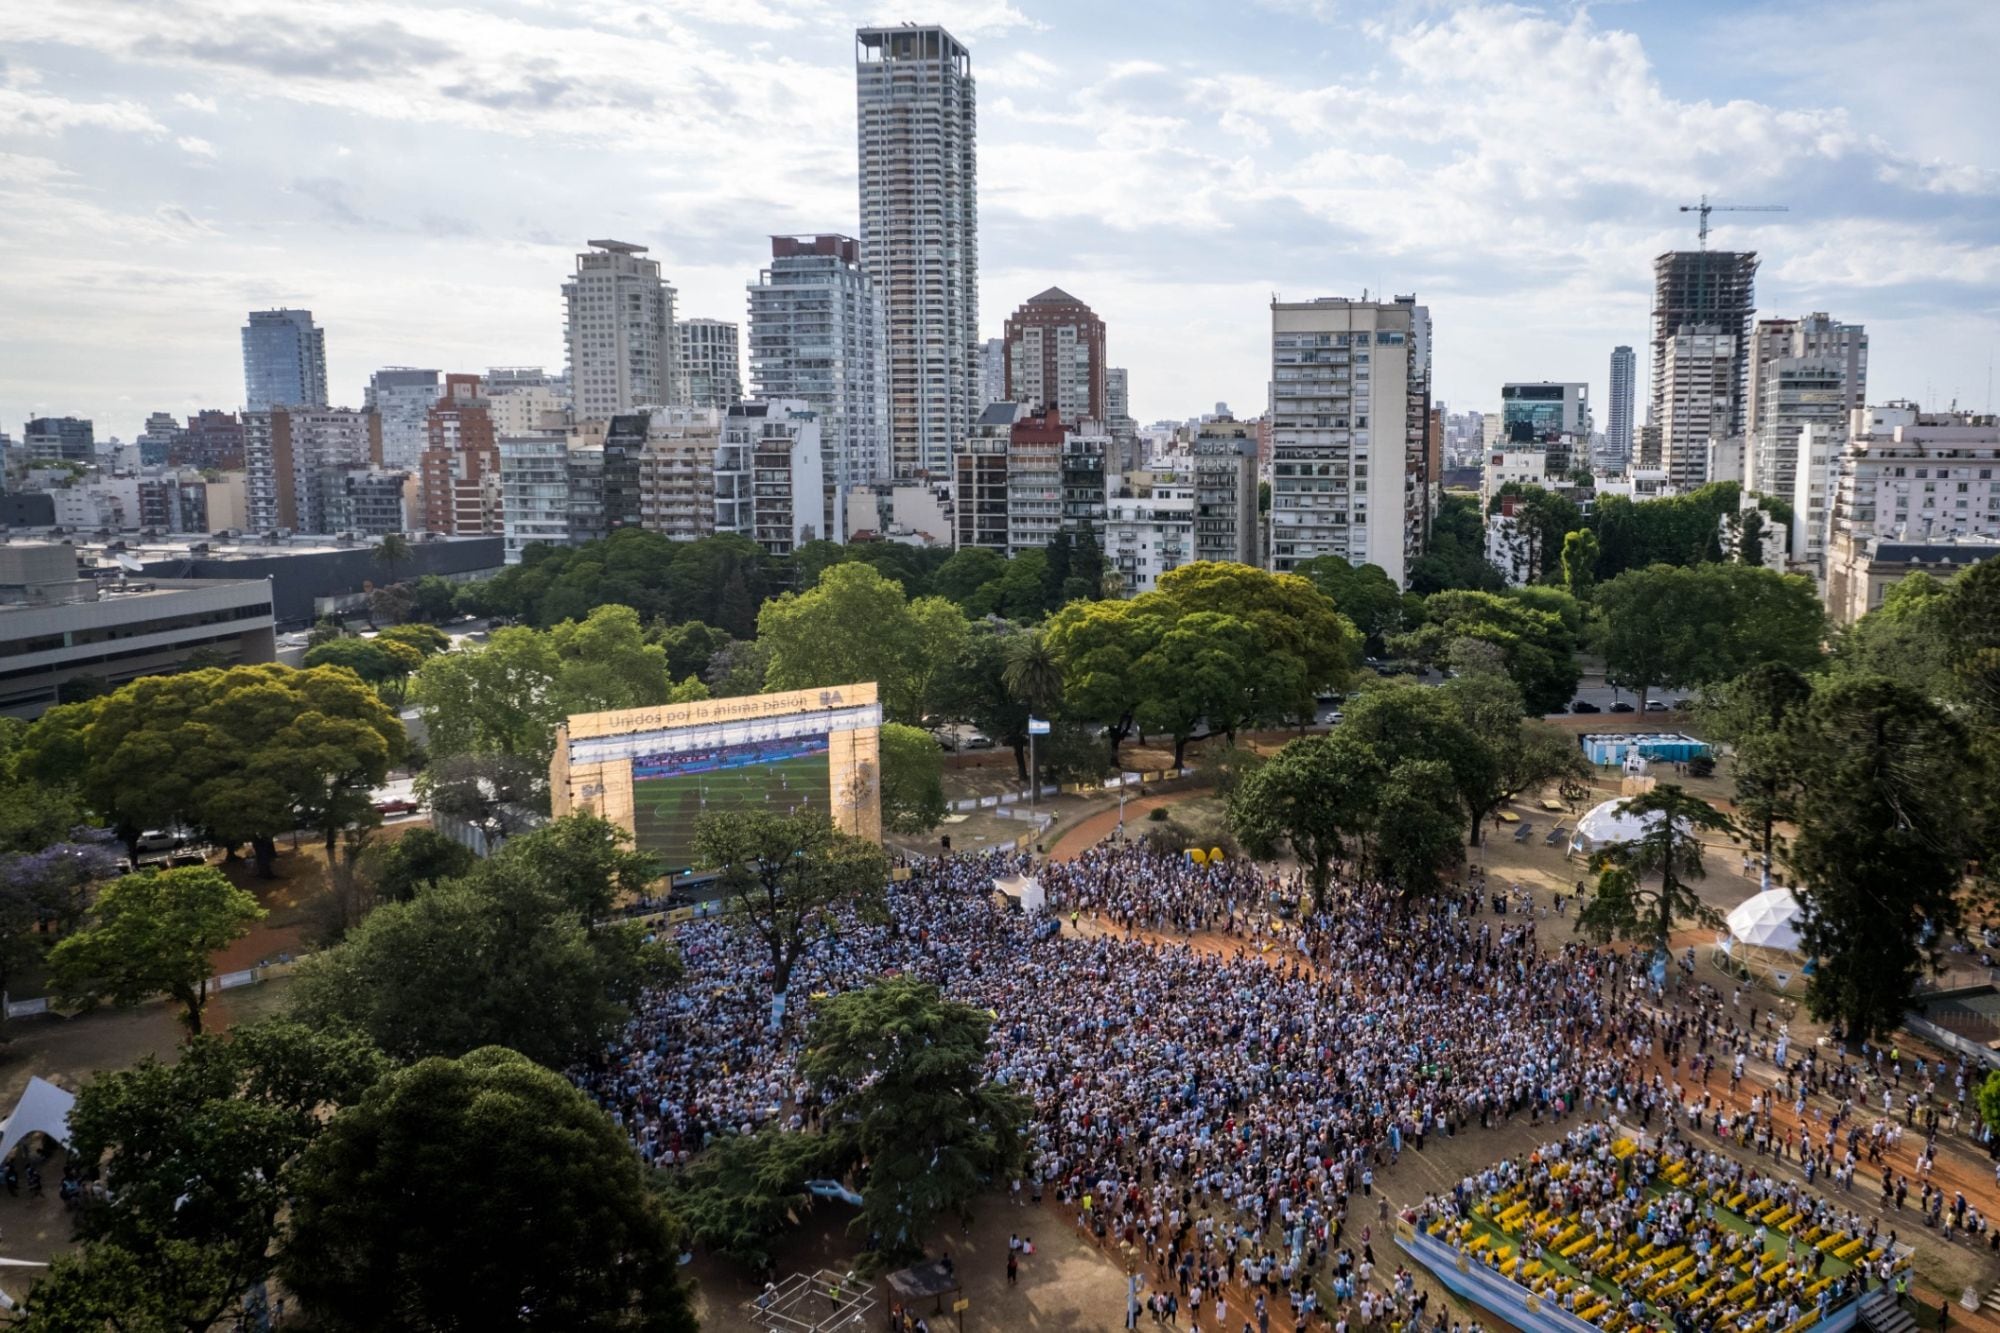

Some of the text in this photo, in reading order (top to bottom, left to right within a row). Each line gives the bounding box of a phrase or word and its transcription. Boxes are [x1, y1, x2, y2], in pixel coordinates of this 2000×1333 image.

[819, 690, 844, 706] BA
[609, 696, 808, 728] Unidos por la misma pasión
